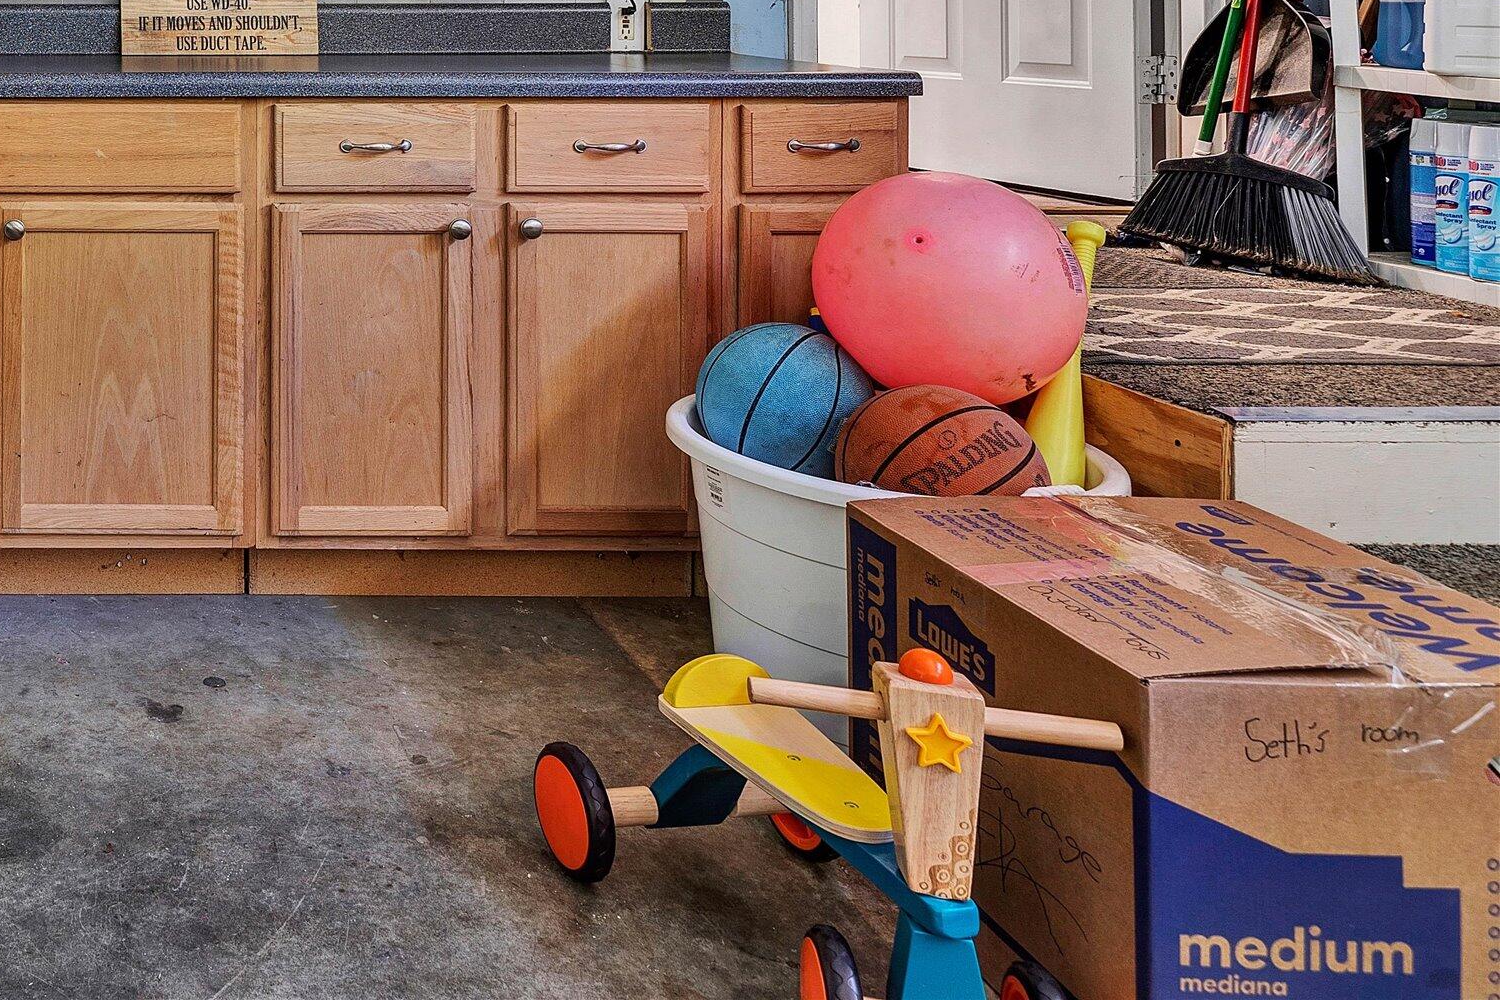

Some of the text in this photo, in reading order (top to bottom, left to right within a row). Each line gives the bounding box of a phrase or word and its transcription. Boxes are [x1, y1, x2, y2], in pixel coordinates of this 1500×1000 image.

[138, 15, 303, 32] IF IT MOVES AND SHOULDN'T,
[176, 35, 267, 51] USE DUCT TAPE.
[1443, 216, 1464, 225] Spray
[1476, 222, 1497, 231] Spray
[898, 421, 1020, 495] SPALDING
[856, 546, 867, 623] mediana
[1070, 582, 1116, 608] Garage
[1126, 578, 1189, 611] Basement
[916, 607, 986, 683] LOWE'S
[1244, 718, 1420, 764] Seth's room
[1179, 925, 1414, 975] medium
[1179, 974, 1288, 997] mediana
